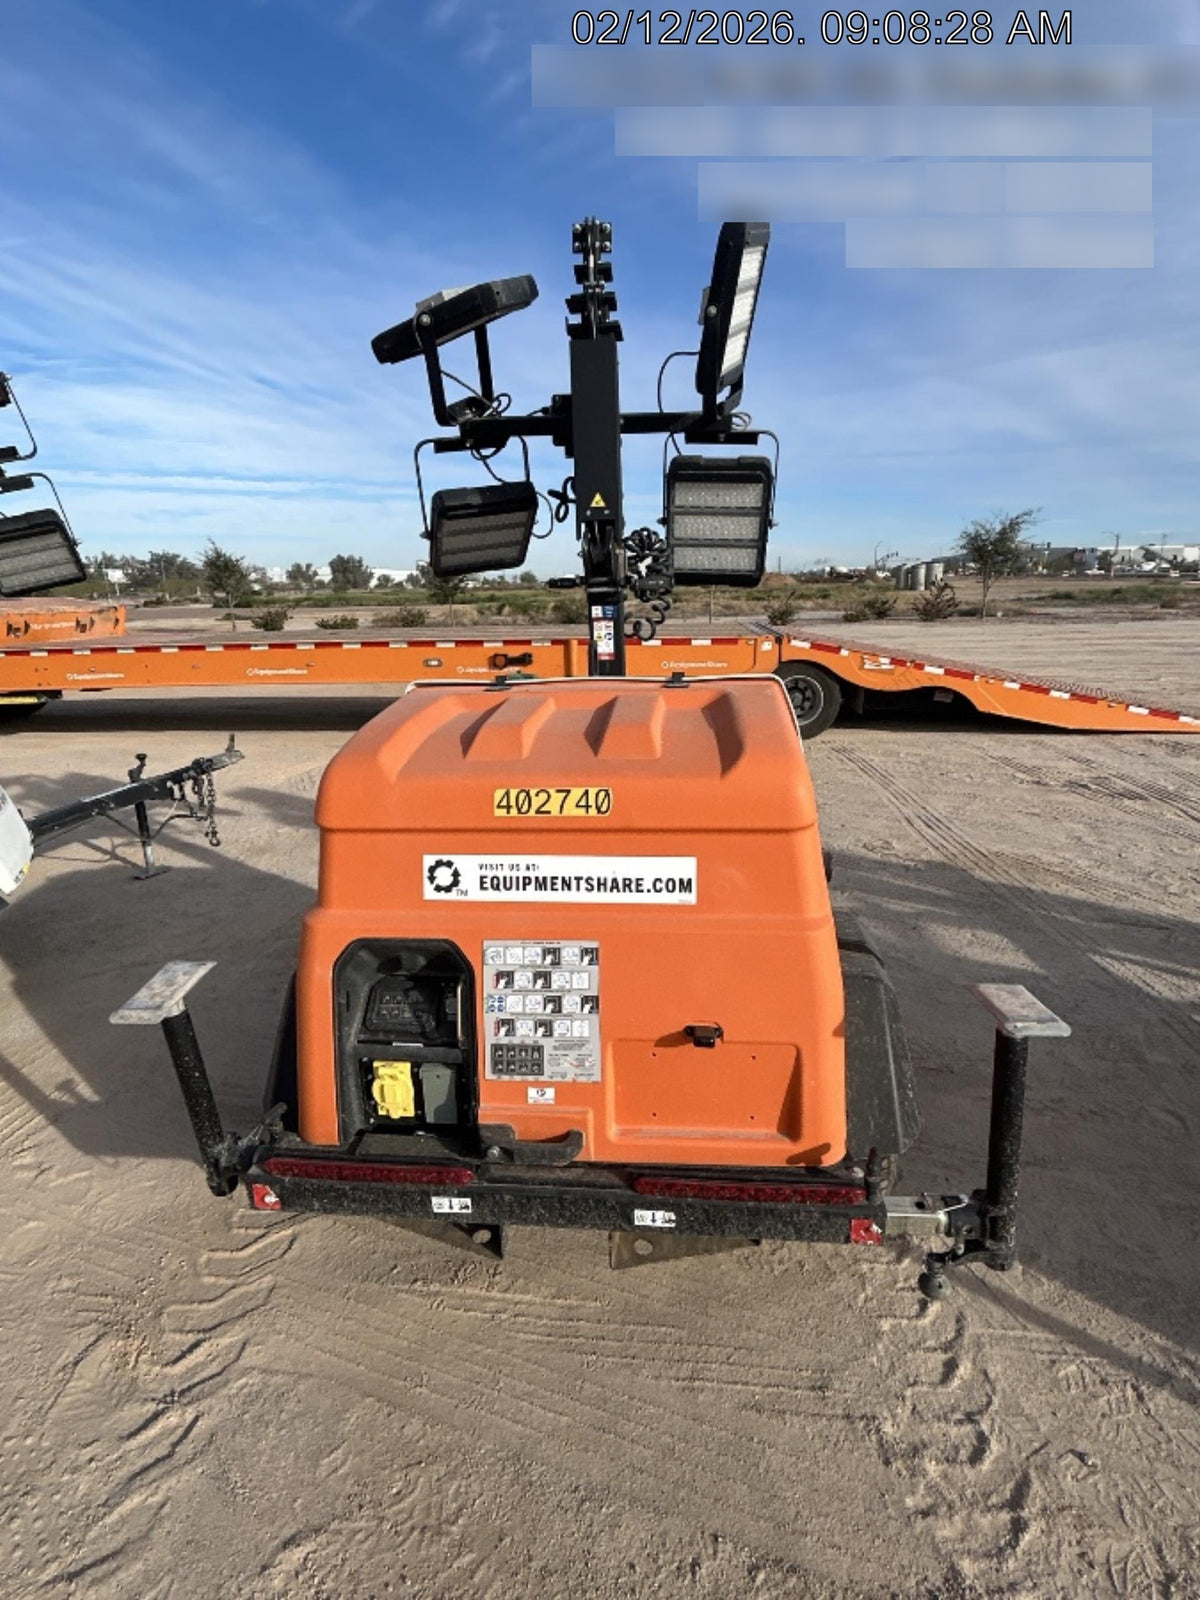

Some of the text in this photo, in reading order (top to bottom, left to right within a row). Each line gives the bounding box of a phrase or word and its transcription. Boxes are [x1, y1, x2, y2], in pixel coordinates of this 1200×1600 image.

[495, 788, 612, 816] 402740
[478, 863, 504, 872] VISIT
[508, 863, 521, 872] US
[479, 874, 693, 895] EQUIPMENTSHARE.COM
